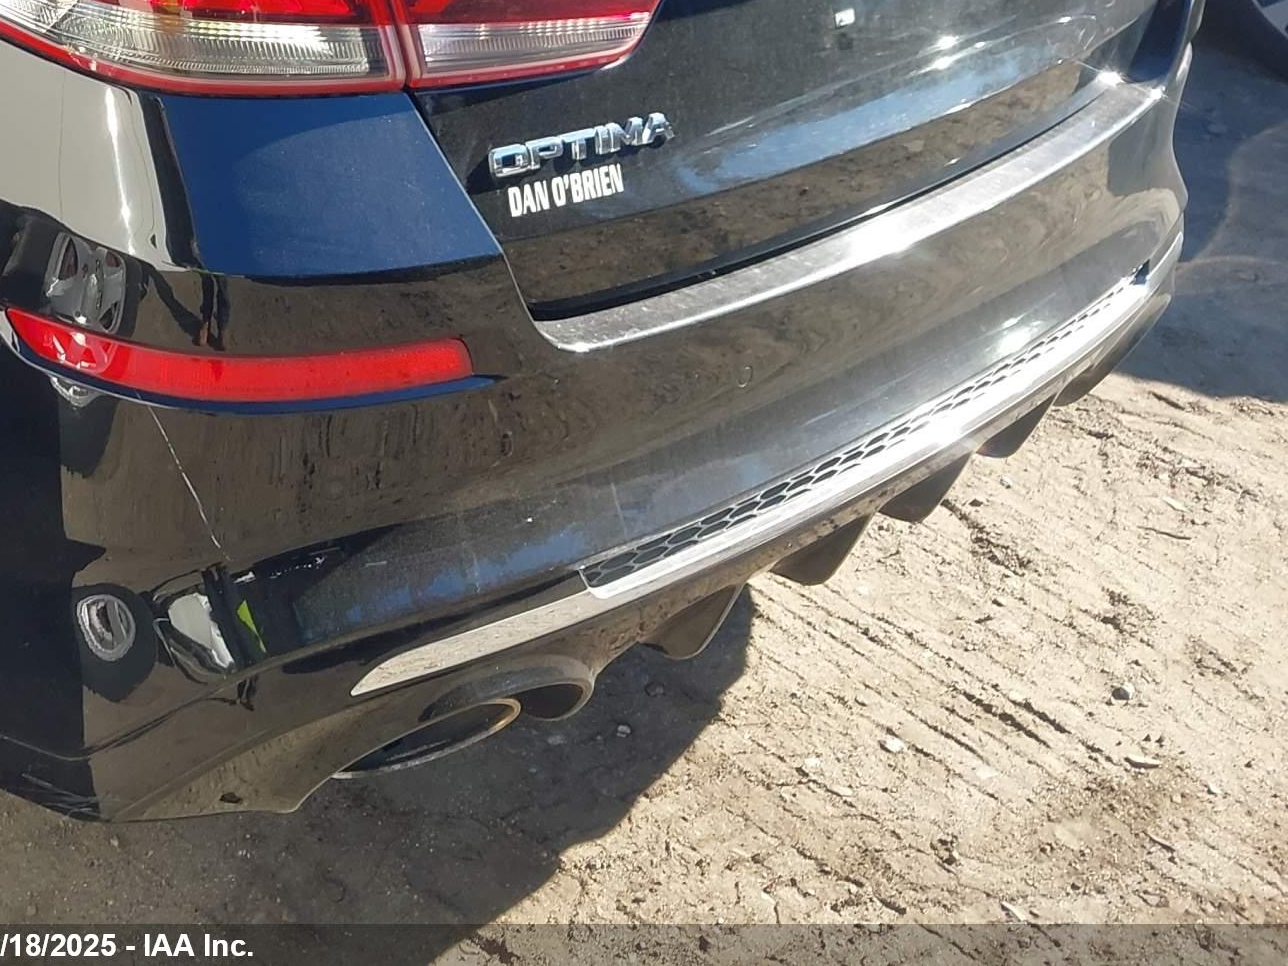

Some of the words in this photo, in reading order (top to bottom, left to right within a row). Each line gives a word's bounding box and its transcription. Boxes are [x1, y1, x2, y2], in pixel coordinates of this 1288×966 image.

[488, 112, 675, 178] OPTIMA
[507, 179, 550, 217] DAN
[551, 163, 624, 207] O'BRIEN
